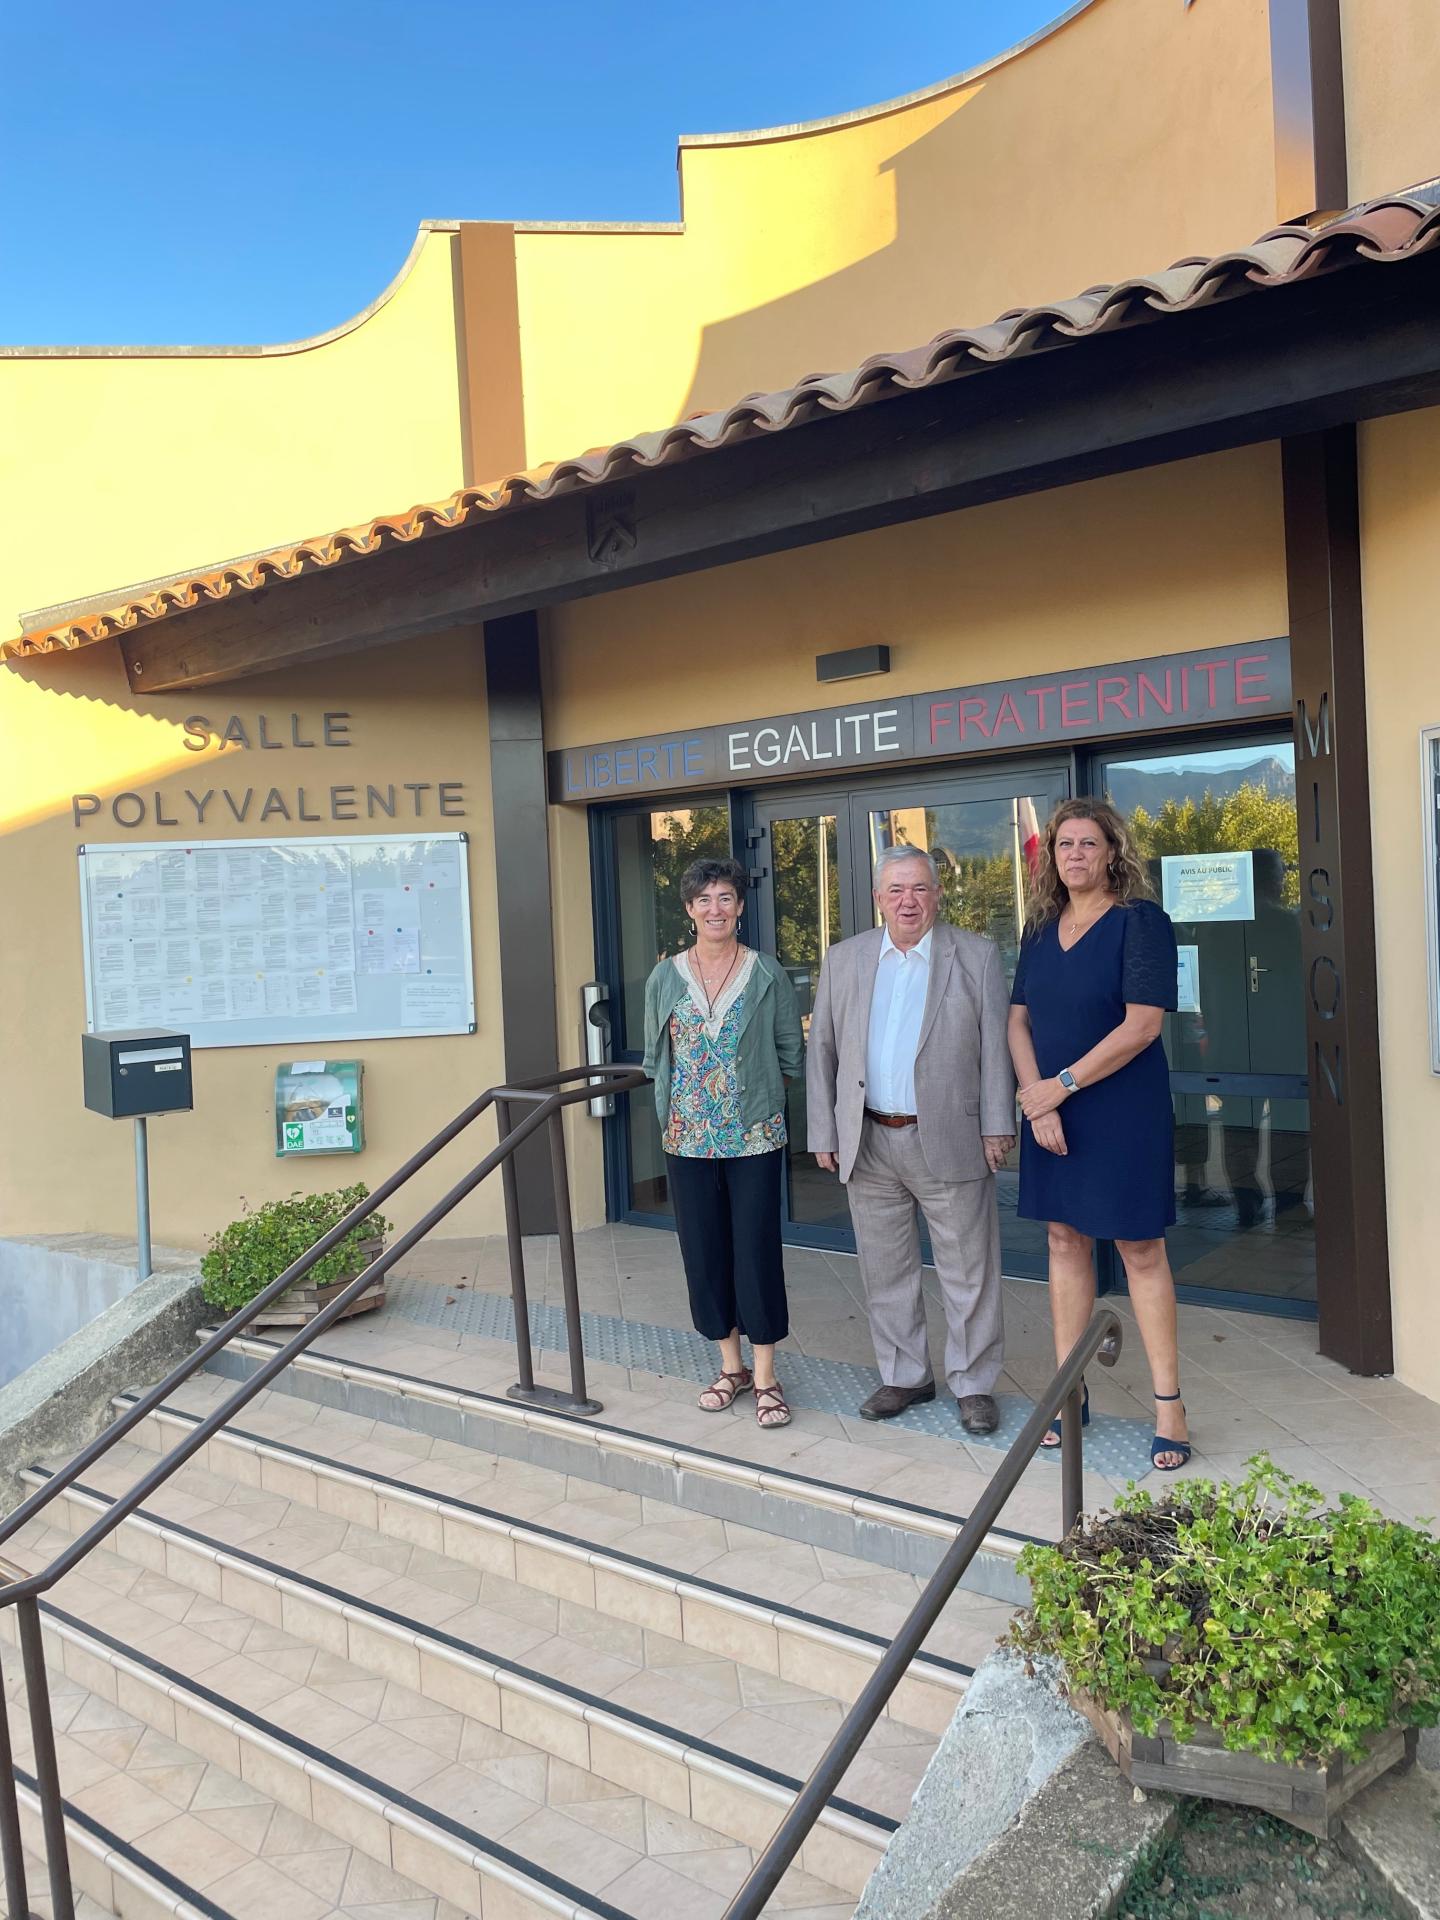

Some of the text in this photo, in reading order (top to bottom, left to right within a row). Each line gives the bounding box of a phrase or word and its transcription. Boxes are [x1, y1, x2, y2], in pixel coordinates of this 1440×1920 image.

[182, 712, 352, 751] SALLE
[565, 654, 1272, 792] LIBERTE EGALITE FRATERNITE
[72, 782, 466, 828] POLYVALENTE
[1180, 866, 1233, 876] AVIS AU PUBLIC
[1297, 692, 1343, 1106] MISON
[287, 1141, 304, 1149] DAE
